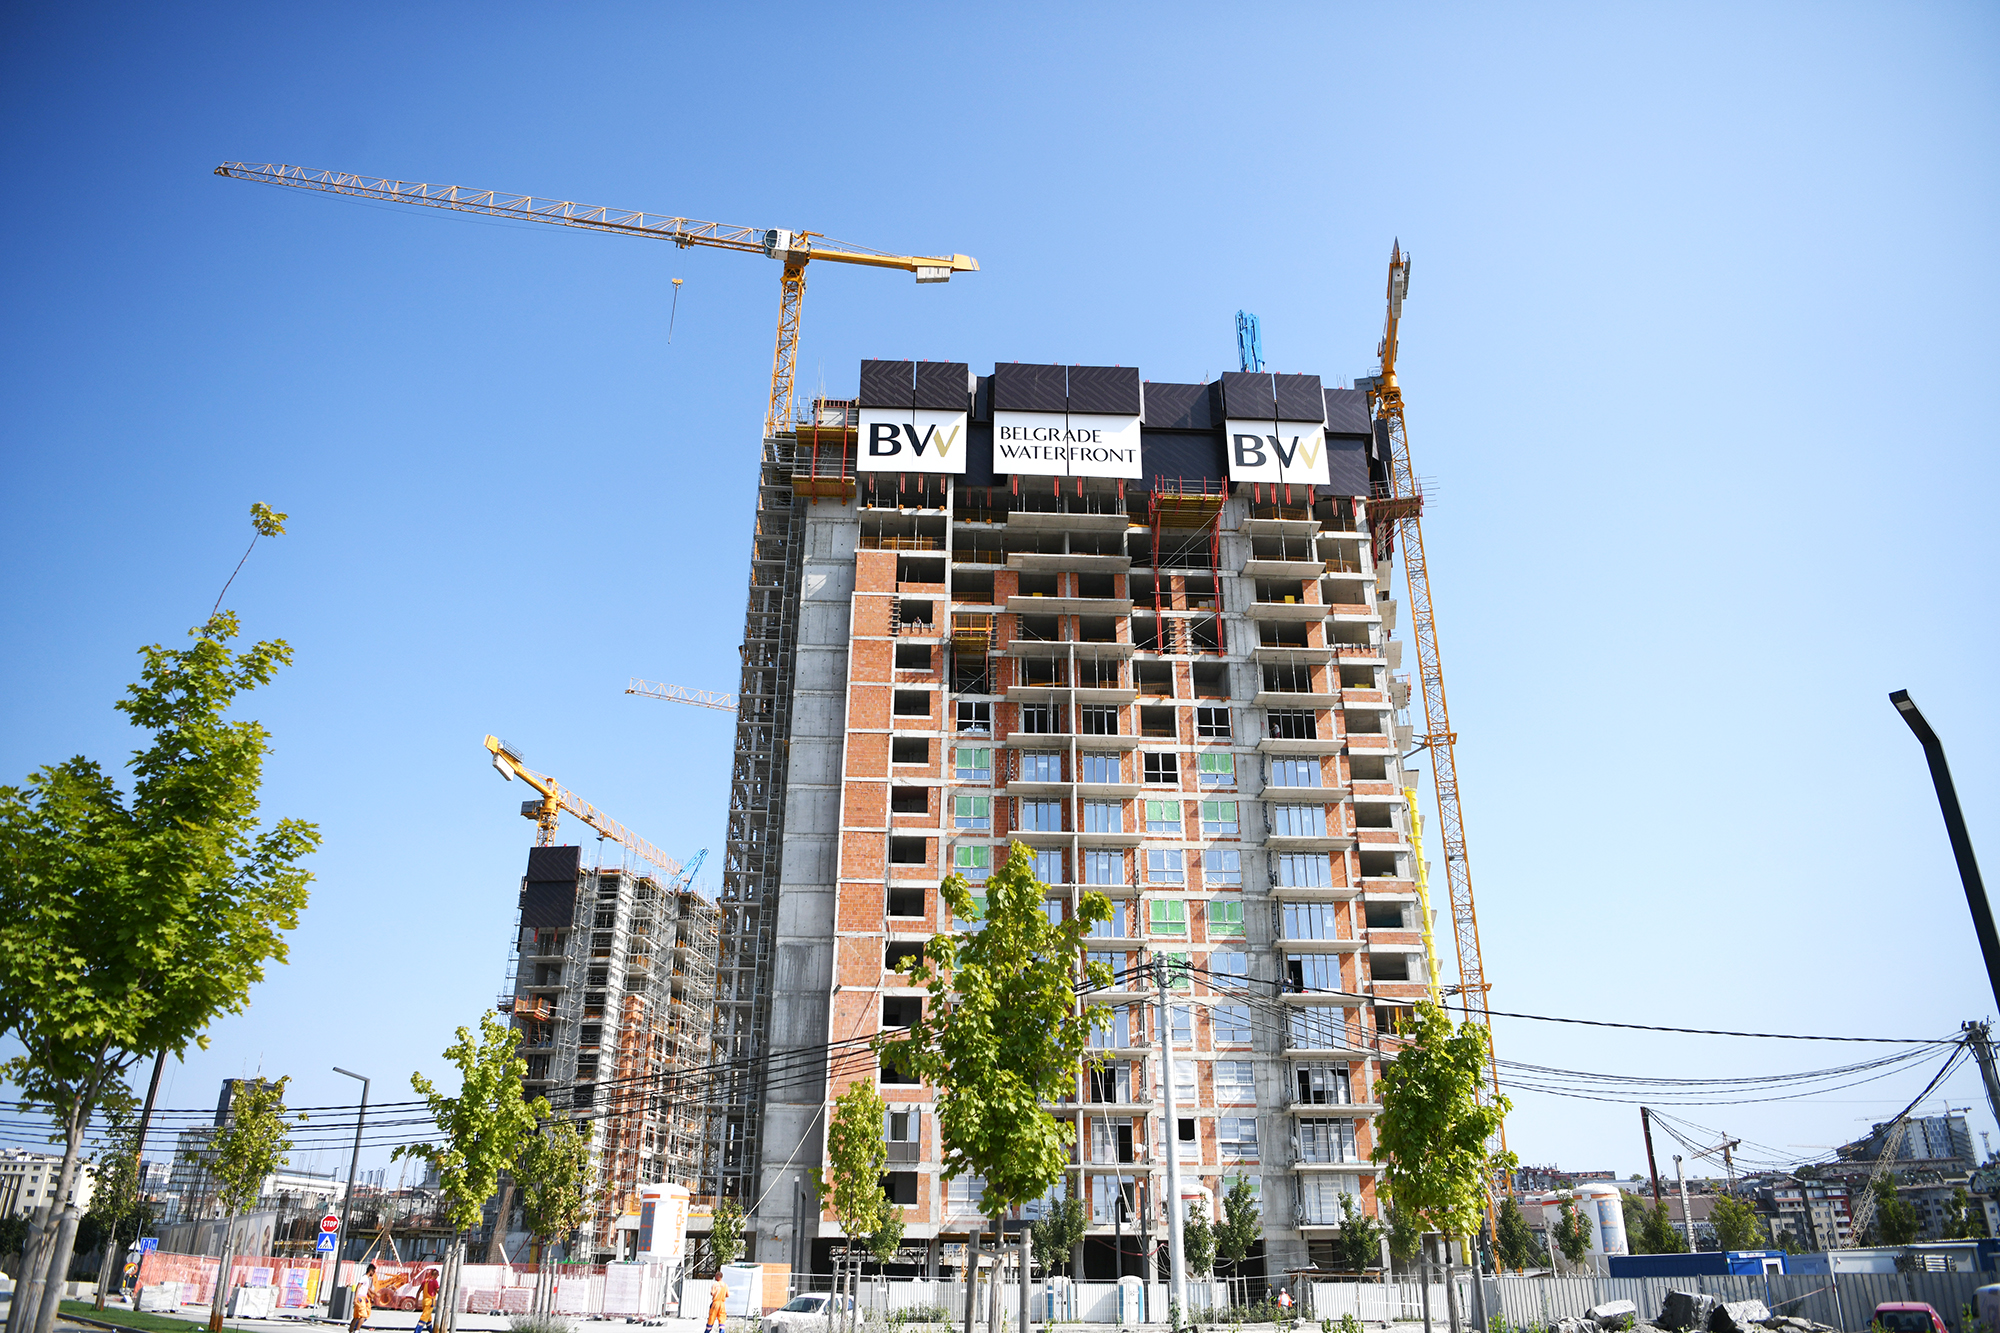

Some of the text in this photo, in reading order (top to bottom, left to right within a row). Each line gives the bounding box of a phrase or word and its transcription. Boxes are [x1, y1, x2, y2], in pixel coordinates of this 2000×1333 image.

[1000, 426, 1101, 444] BELGRADE
[1000, 445, 1136, 463] WATERFRONT
[323, 1220, 338, 1228] STOP
